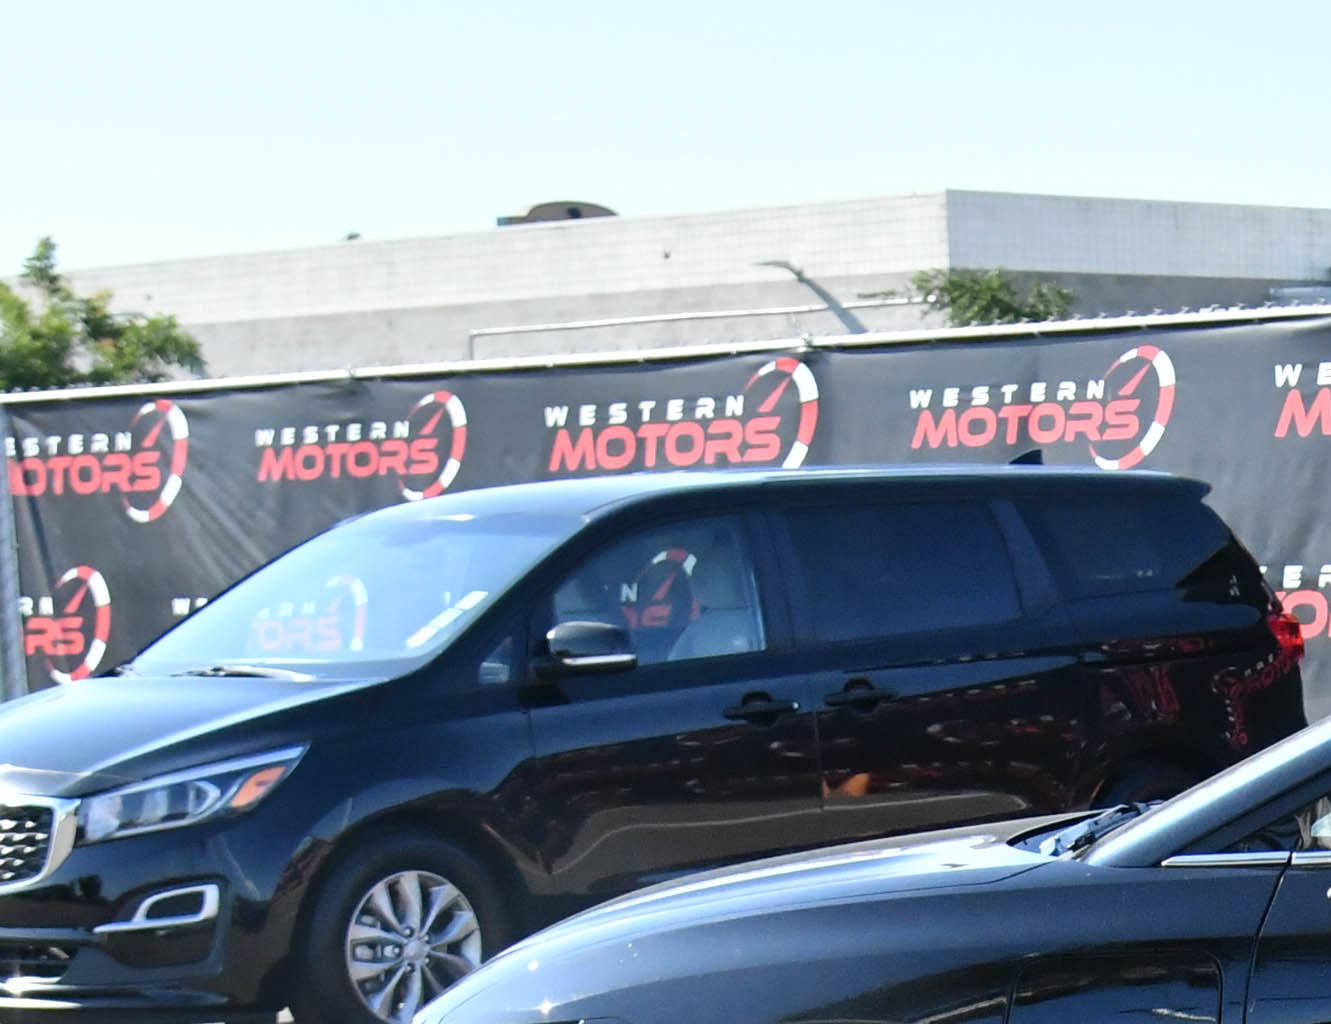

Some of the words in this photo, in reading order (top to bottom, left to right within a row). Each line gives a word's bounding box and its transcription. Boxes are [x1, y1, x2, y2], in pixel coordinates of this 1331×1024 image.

[545, 395, 744, 426] WESTERN
[910, 380, 1104, 408] WESTERN
[256, 421, 409, 446] WESTERN
[912, 400, 1139, 448] MOTORS
[260, 438, 437, 480] MOTORS
[550, 416, 780, 472] MOTORS
